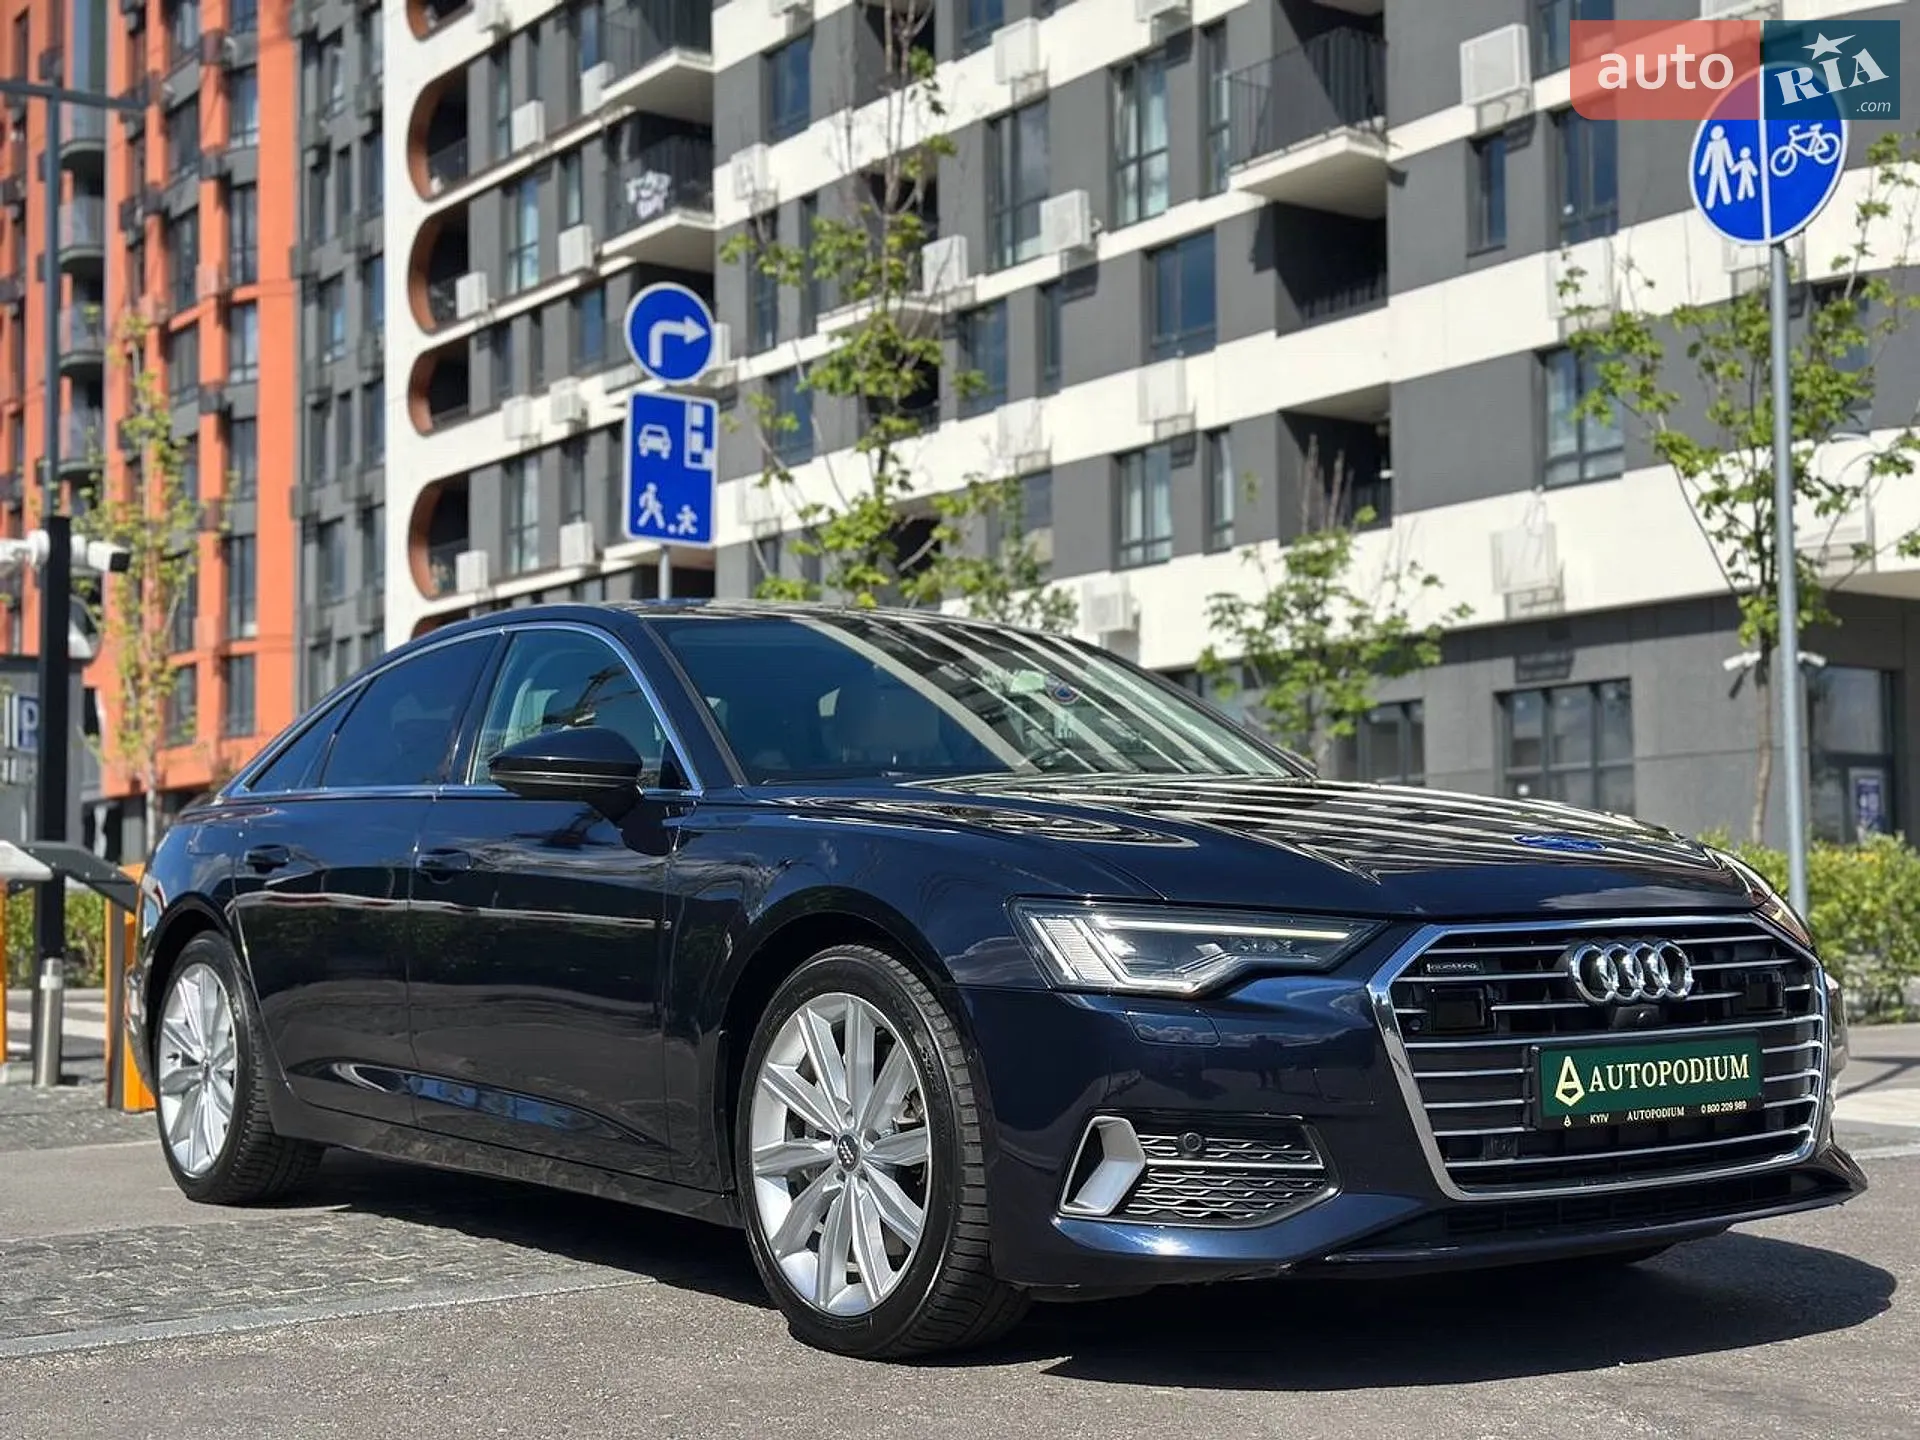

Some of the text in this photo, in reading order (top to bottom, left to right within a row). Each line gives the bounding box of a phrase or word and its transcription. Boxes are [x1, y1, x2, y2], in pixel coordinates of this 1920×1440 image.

[1588, 1054, 1750, 1092] AUTOPODIUM
[1590, 1112, 1609, 1124] KYIV
[1626, 1106, 1685, 1121] AUTOPODIUM
[1707, 1103, 1720, 1113] 800
